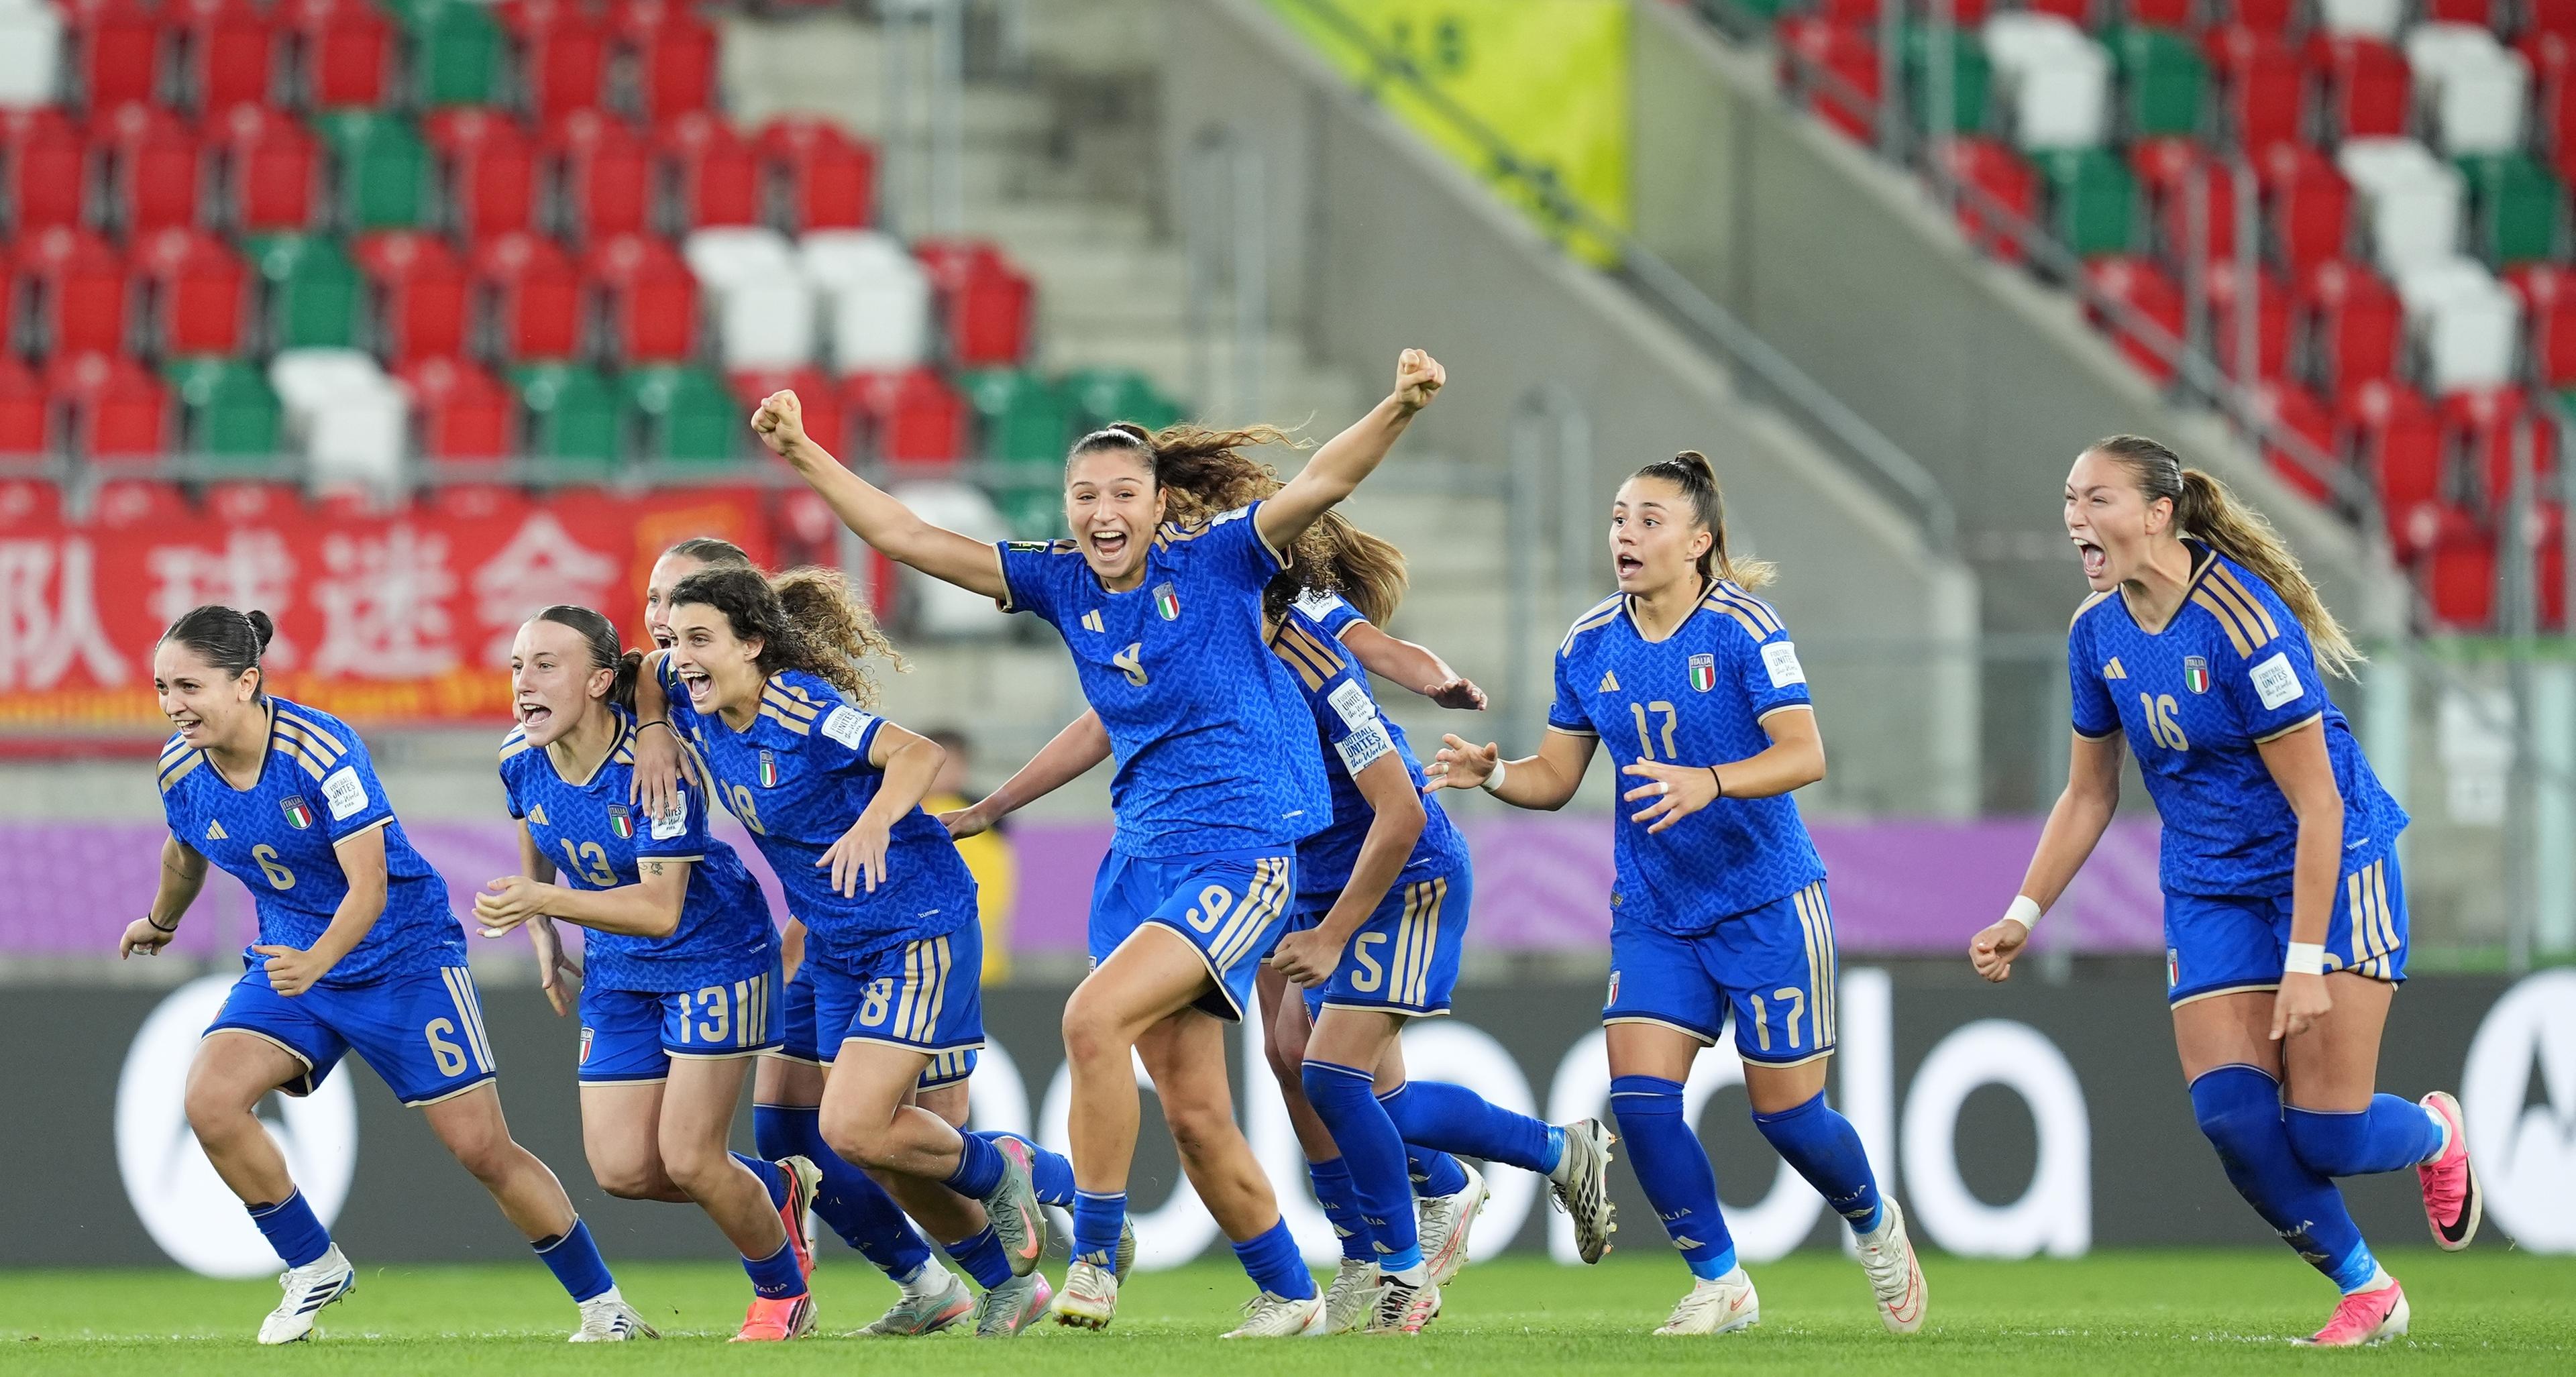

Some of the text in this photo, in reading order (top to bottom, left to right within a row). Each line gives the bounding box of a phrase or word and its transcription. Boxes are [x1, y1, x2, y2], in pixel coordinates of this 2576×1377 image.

[1690, 657, 1711, 665] ITALIA
[2259, 663, 2283, 680] FOOTBALL
[2262, 670, 2288, 689] UNITES
[1337, 687, 1357, 704] FOOTBALL
[1342, 692, 1362, 711] UNITES
[830, 710, 848, 731] FOOTBALL
[836, 712, 855, 734] UNITES
[1630, 701, 1677, 760] 17
[2139, 692, 2189, 751] 16
[1342, 726, 1374, 748] FOOTBALL
[1345, 732, 1381, 758] UNITES
[1350, 757, 1362, 768] the
[1362, 740, 1389, 761] World
[329, 775, 352, 791] FOOTBALL
[333, 781, 356, 799] UNITES
[282, 797, 302, 809] ITALIA
[665, 806, 682, 817] NITES
[720, 778, 765, 836] 18
[252, 844, 296, 890] 6
[560, 838, 619, 887] 13
[1185, 885, 1232, 933] 9
[1350, 932, 1387, 993] 5
[678, 985, 729, 1043] 13
[859, 978, 894, 1027] 8
[1750, 987, 1805, 1051] 17
[425, 1017, 468, 1077] 6
